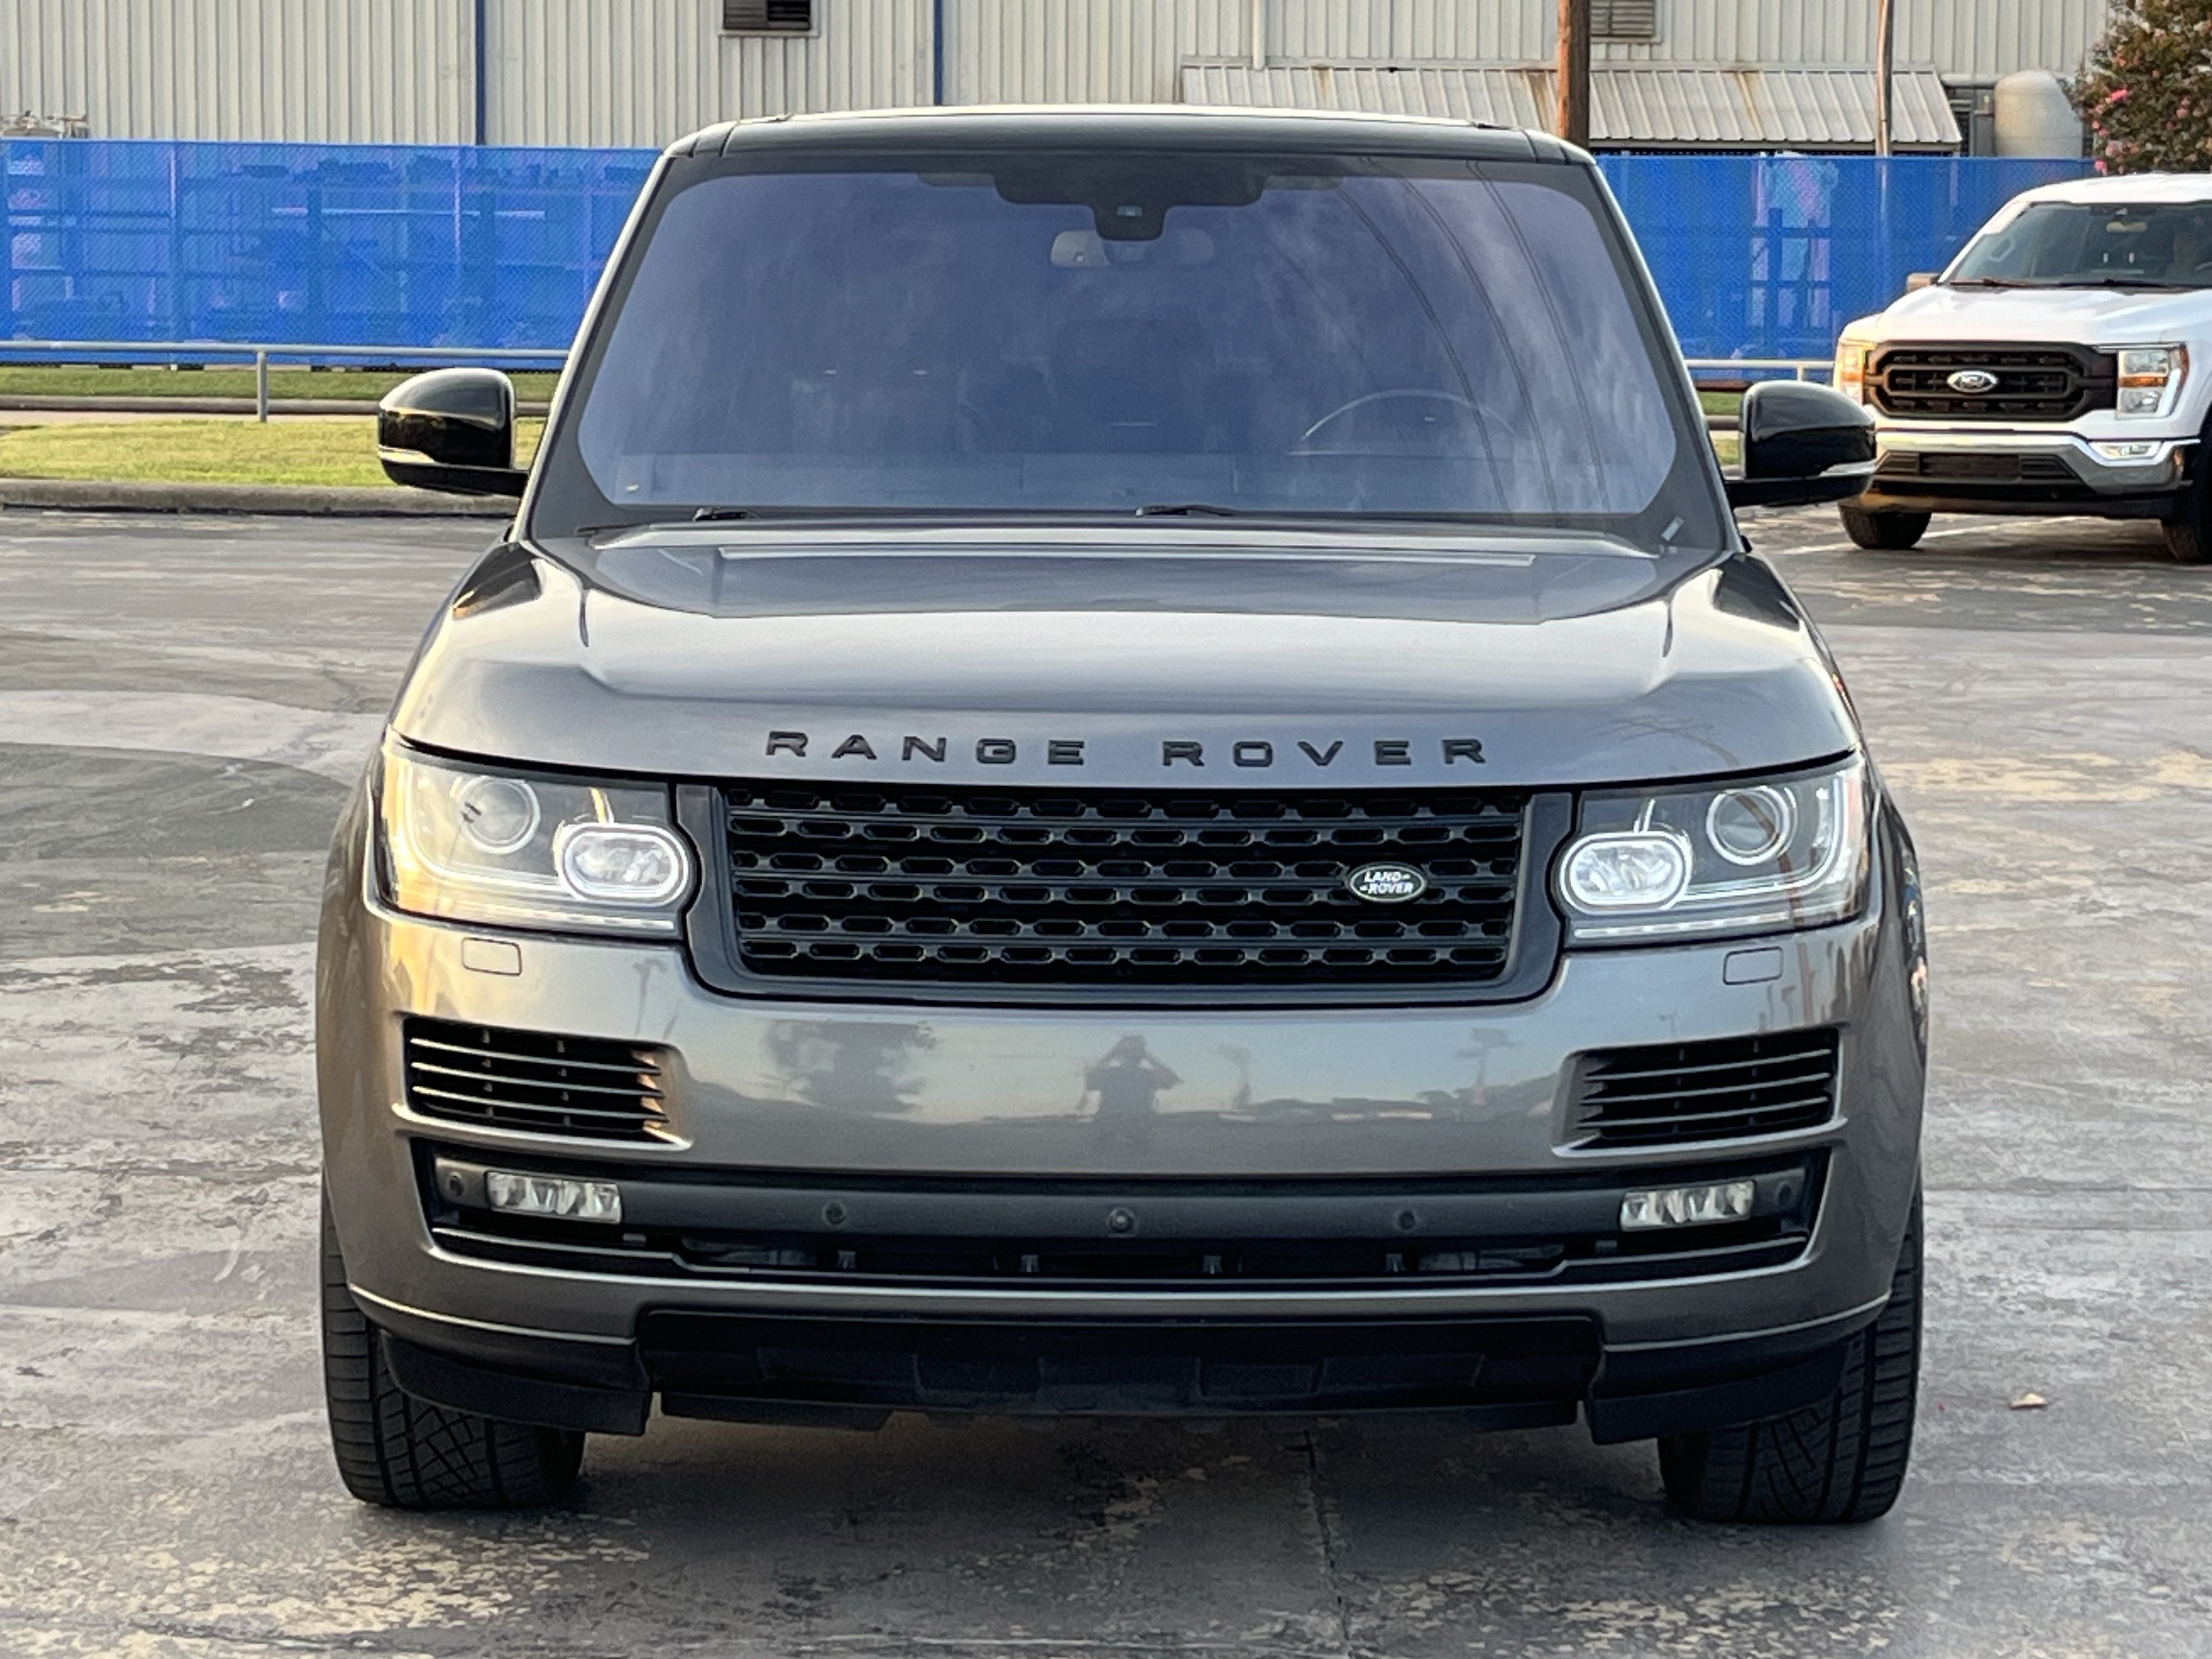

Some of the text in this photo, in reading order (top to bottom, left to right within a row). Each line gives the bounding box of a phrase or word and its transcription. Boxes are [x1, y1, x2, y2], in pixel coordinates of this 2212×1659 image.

[765, 731, 1486, 768] RANGE ROVER
[1364, 871, 1402, 883] LAND
[1368, 882, 1414, 894] ROVER
